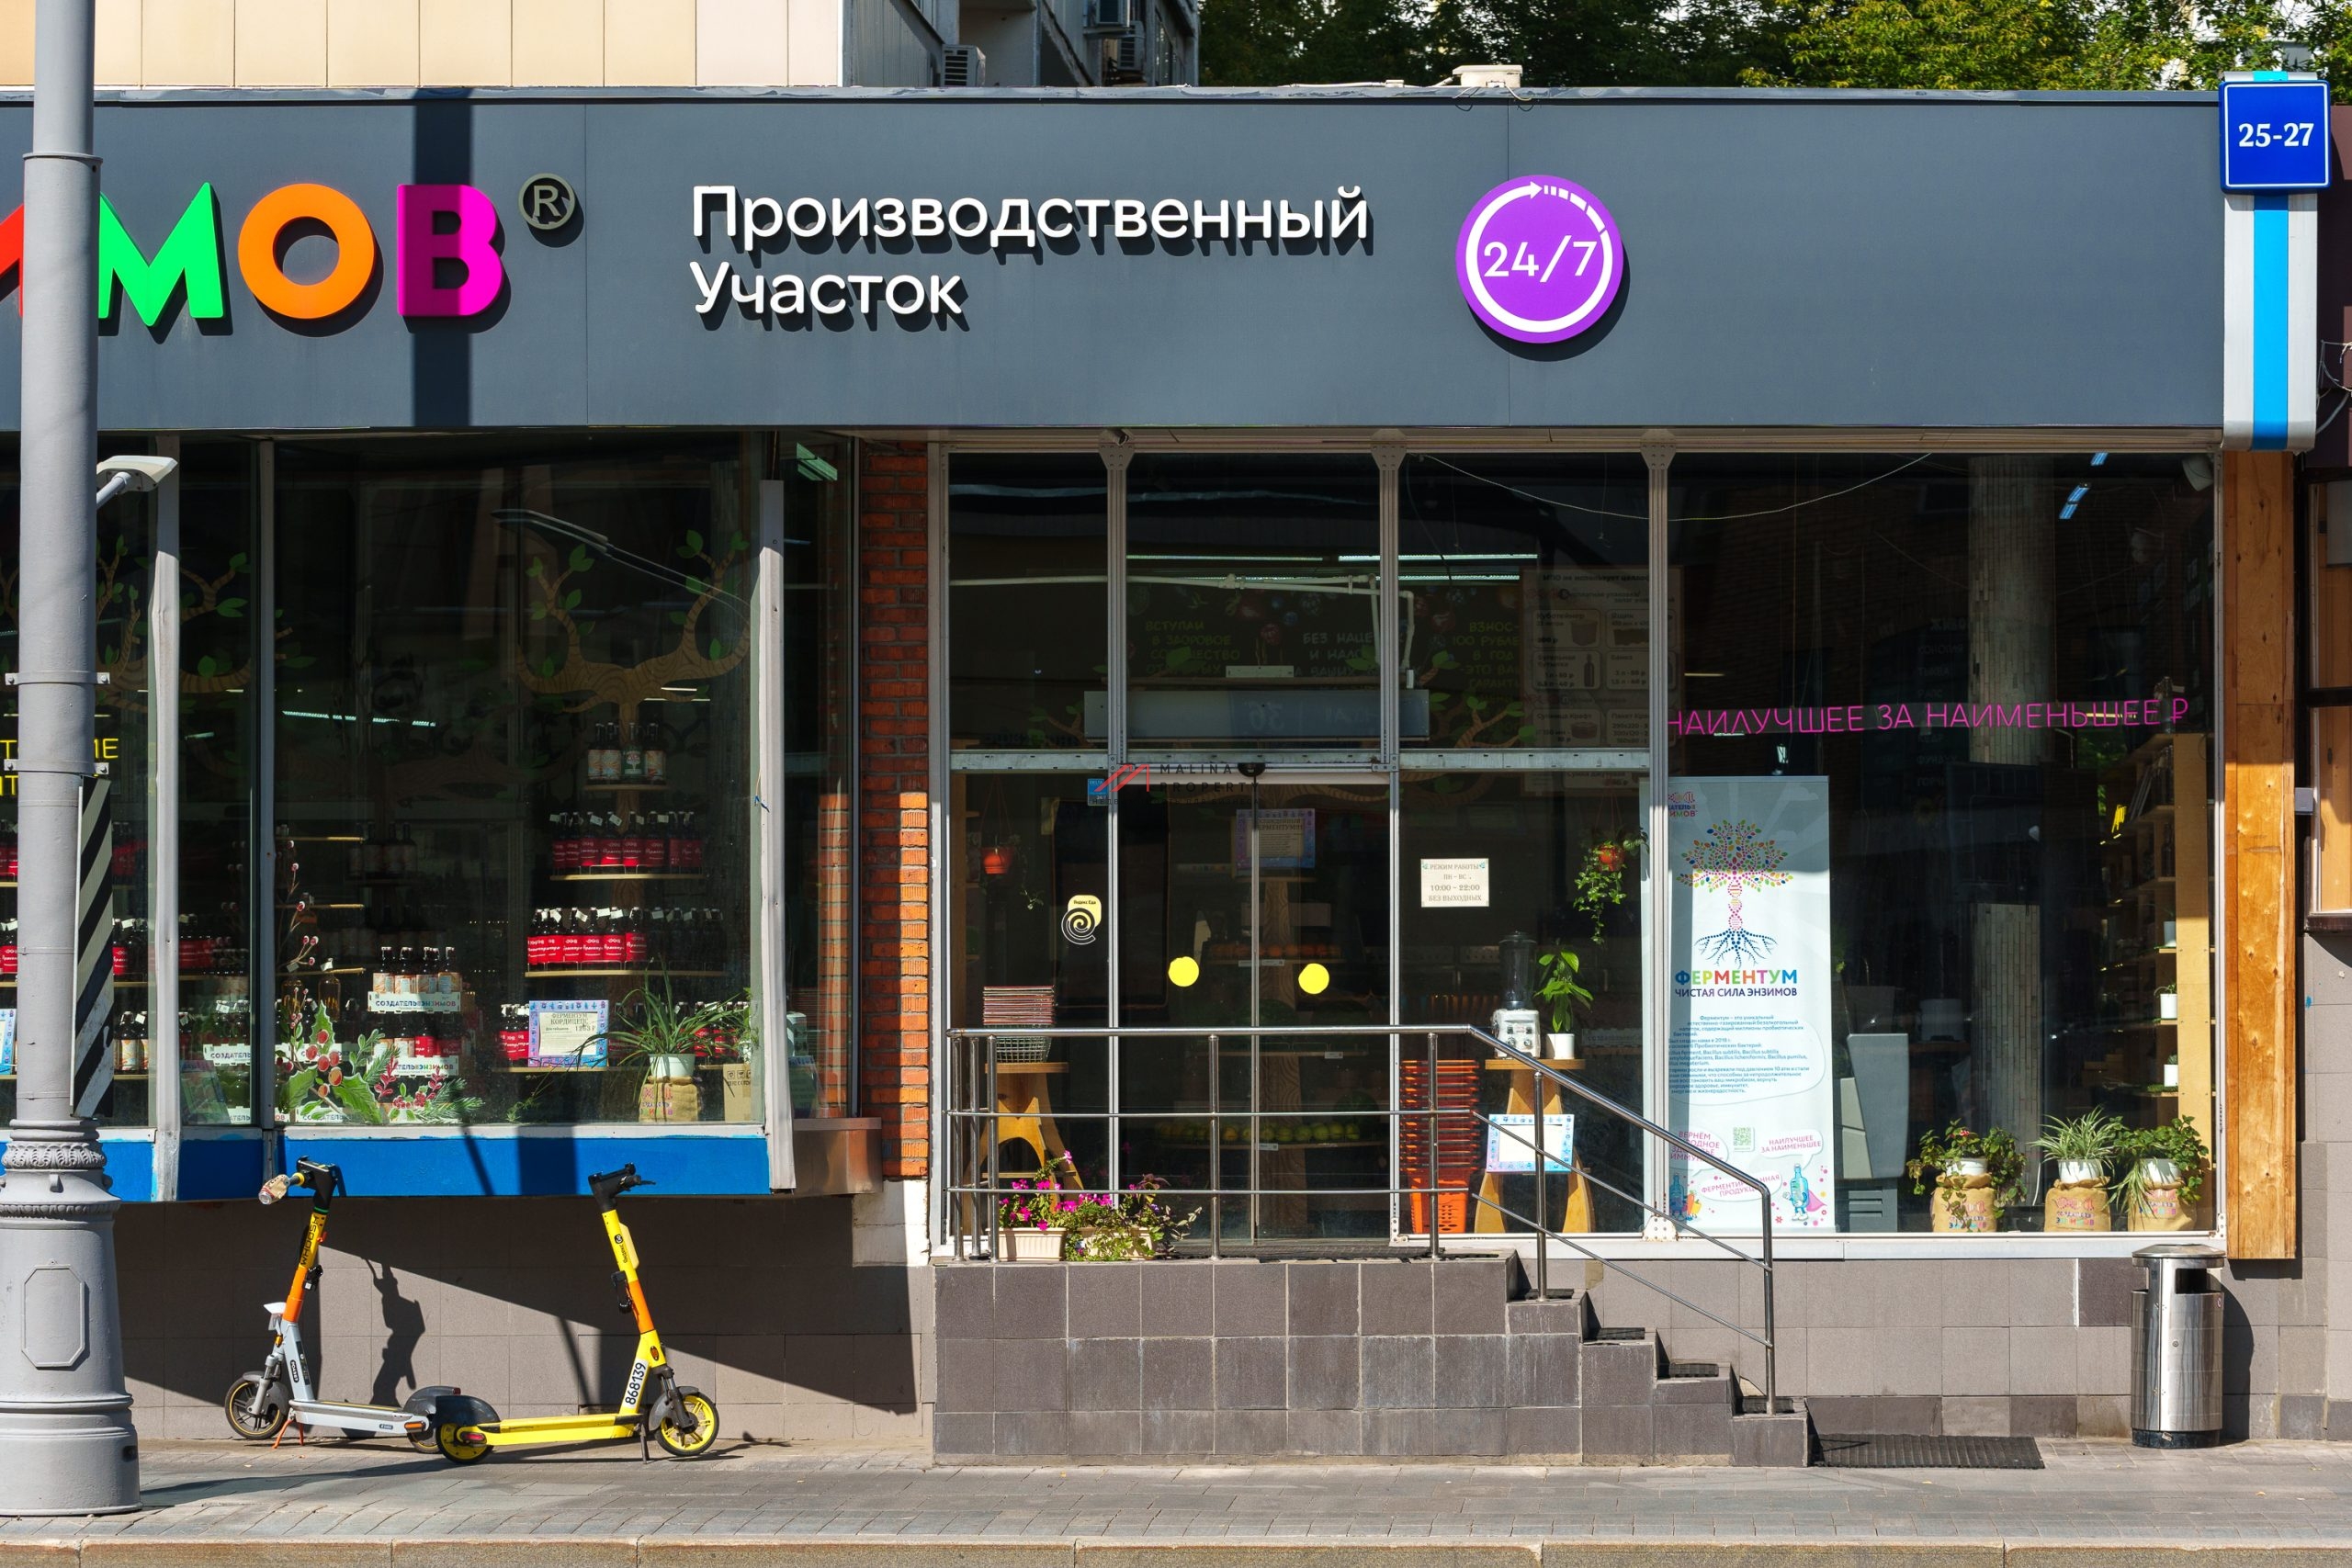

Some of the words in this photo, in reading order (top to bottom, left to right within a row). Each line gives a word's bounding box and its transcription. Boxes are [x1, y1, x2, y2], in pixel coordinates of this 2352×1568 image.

[2238, 122, 2315, 148] 25-27
[693, 185, 1369, 253] Производственный
[1484, 235, 1598, 283] 24/7
[689, 261, 964, 315] Участок
[1668, 705, 1865, 736] НАИЛУЧШЕЕ
[1877, 703, 1916, 731] ЗА
[1926, 699, 2162, 729] НАИМЕНЬШЕЕ
[1442, 894, 1482, 902] ВЫХОДНЫХ
[1675, 970, 1797, 985] ФЕРМЕНТУМ
[1675, 988, 1715, 998] ЧИСТАЯ
[1717, 988, 1746, 997] СИЛА
[1747, 987, 1797, 997] ЭНЗИМОВ
[1679, 1131, 1711, 1141] ВЕРНЁМ
[1761, 1145, 1771, 1154] ЗА
[1772, 1139, 1822, 1152] НАИМЕНЬШЕЕ
[1769, 1134, 1814, 1146] НАИЛУЧШЕЕ
[300, 1215, 320, 1265] WHOOSH
[625, 1362, 646, 1404] 868139
